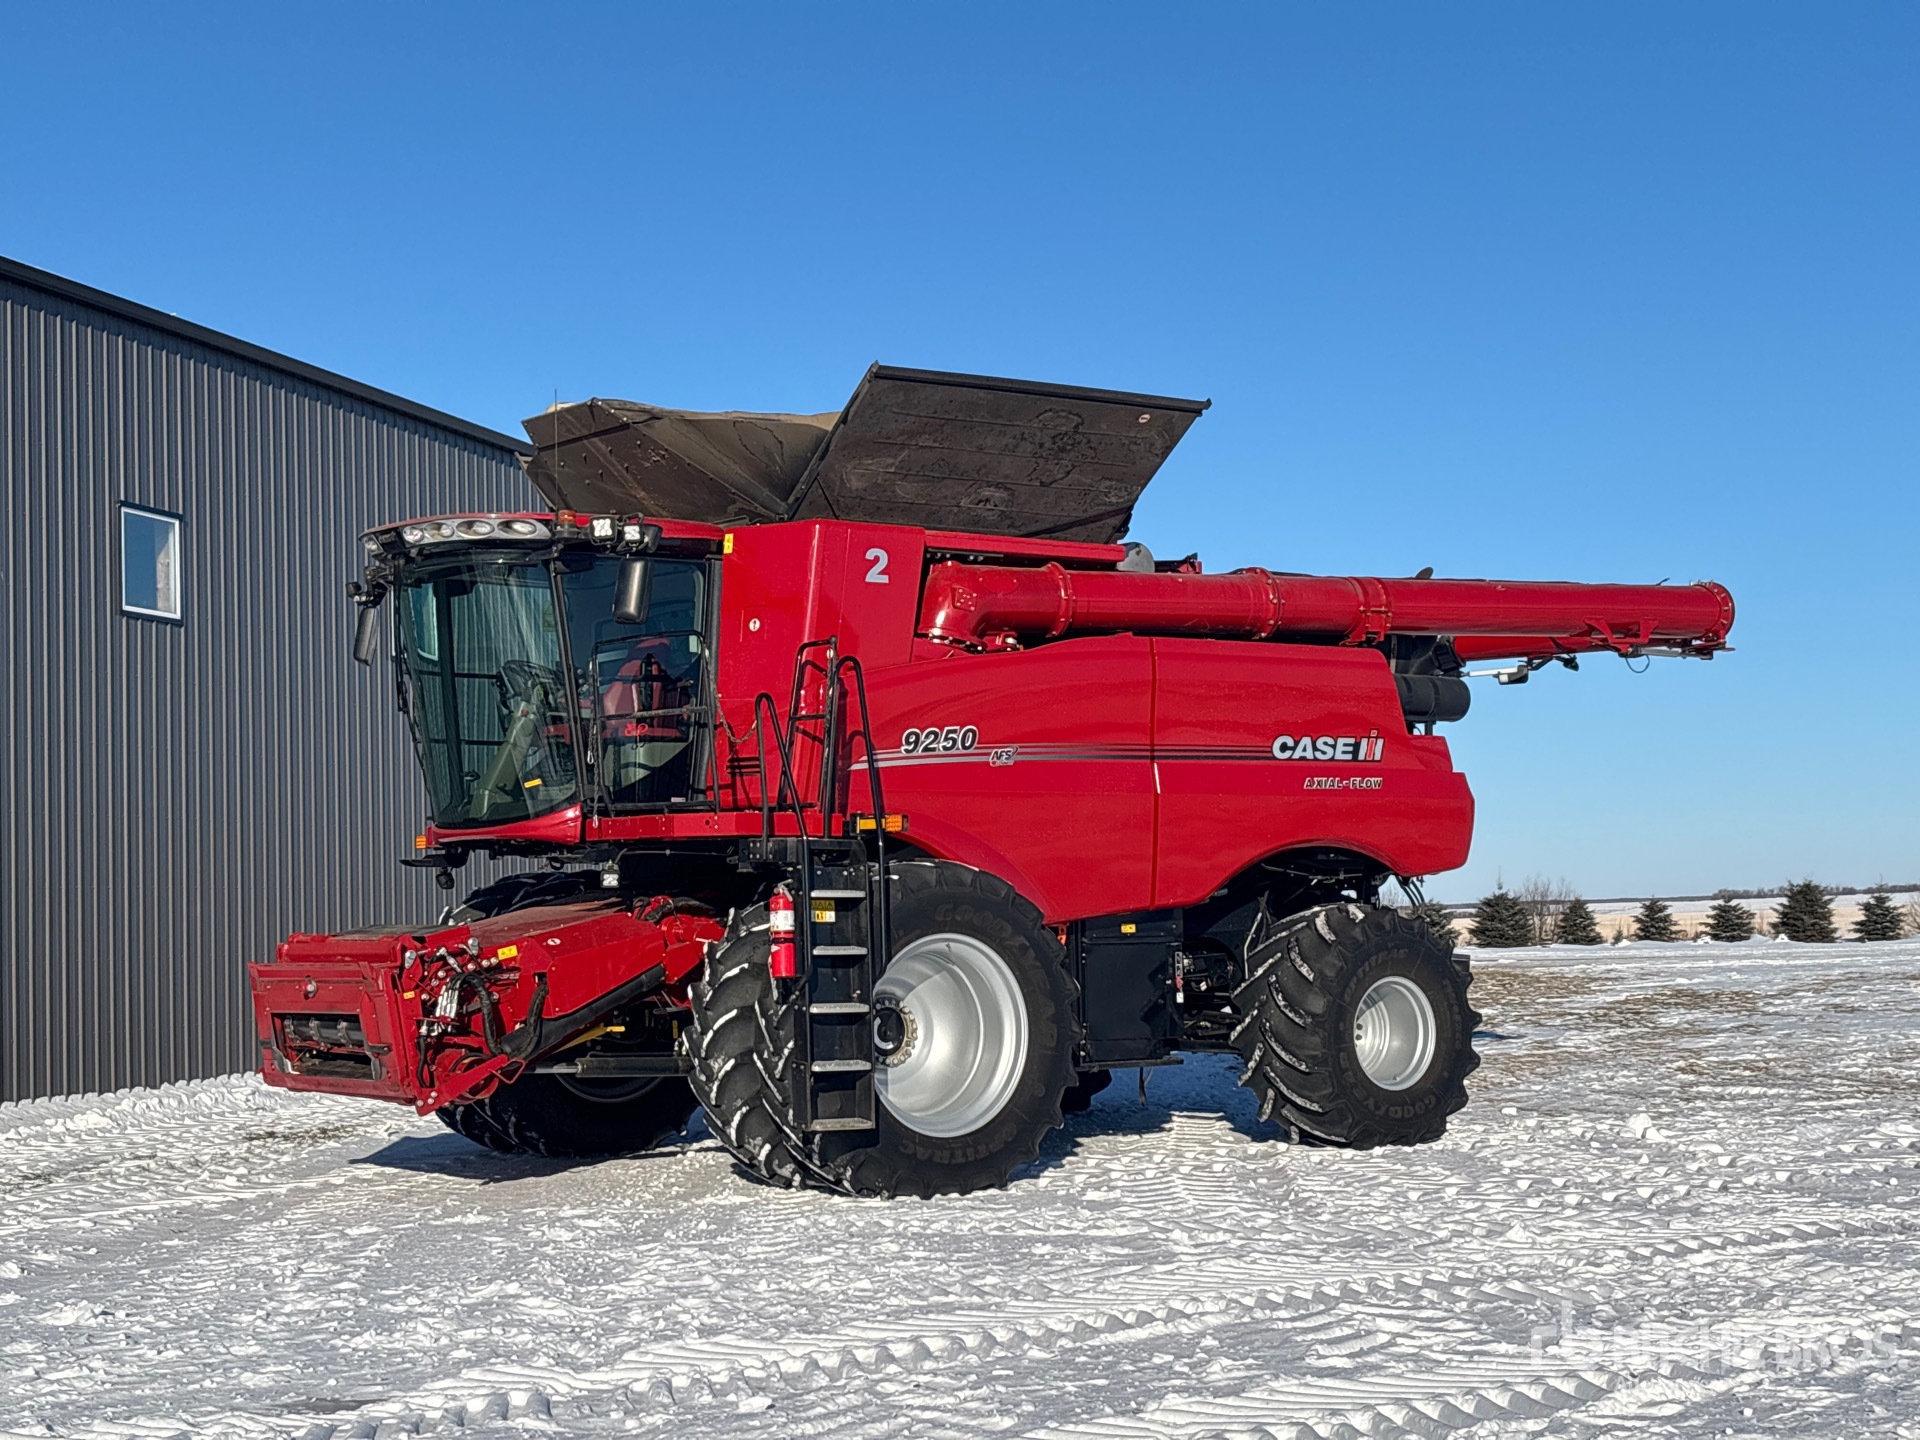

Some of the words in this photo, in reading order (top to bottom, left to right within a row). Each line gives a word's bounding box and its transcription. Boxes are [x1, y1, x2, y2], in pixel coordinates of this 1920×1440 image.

[865, 548, 889, 583] 2
[901, 725, 978, 754] 9250
[1272, 735, 1356, 760] CASE
[990, 749, 1013, 761] AFS
[1303, 777, 1382, 790] AXIAL-FLOW
